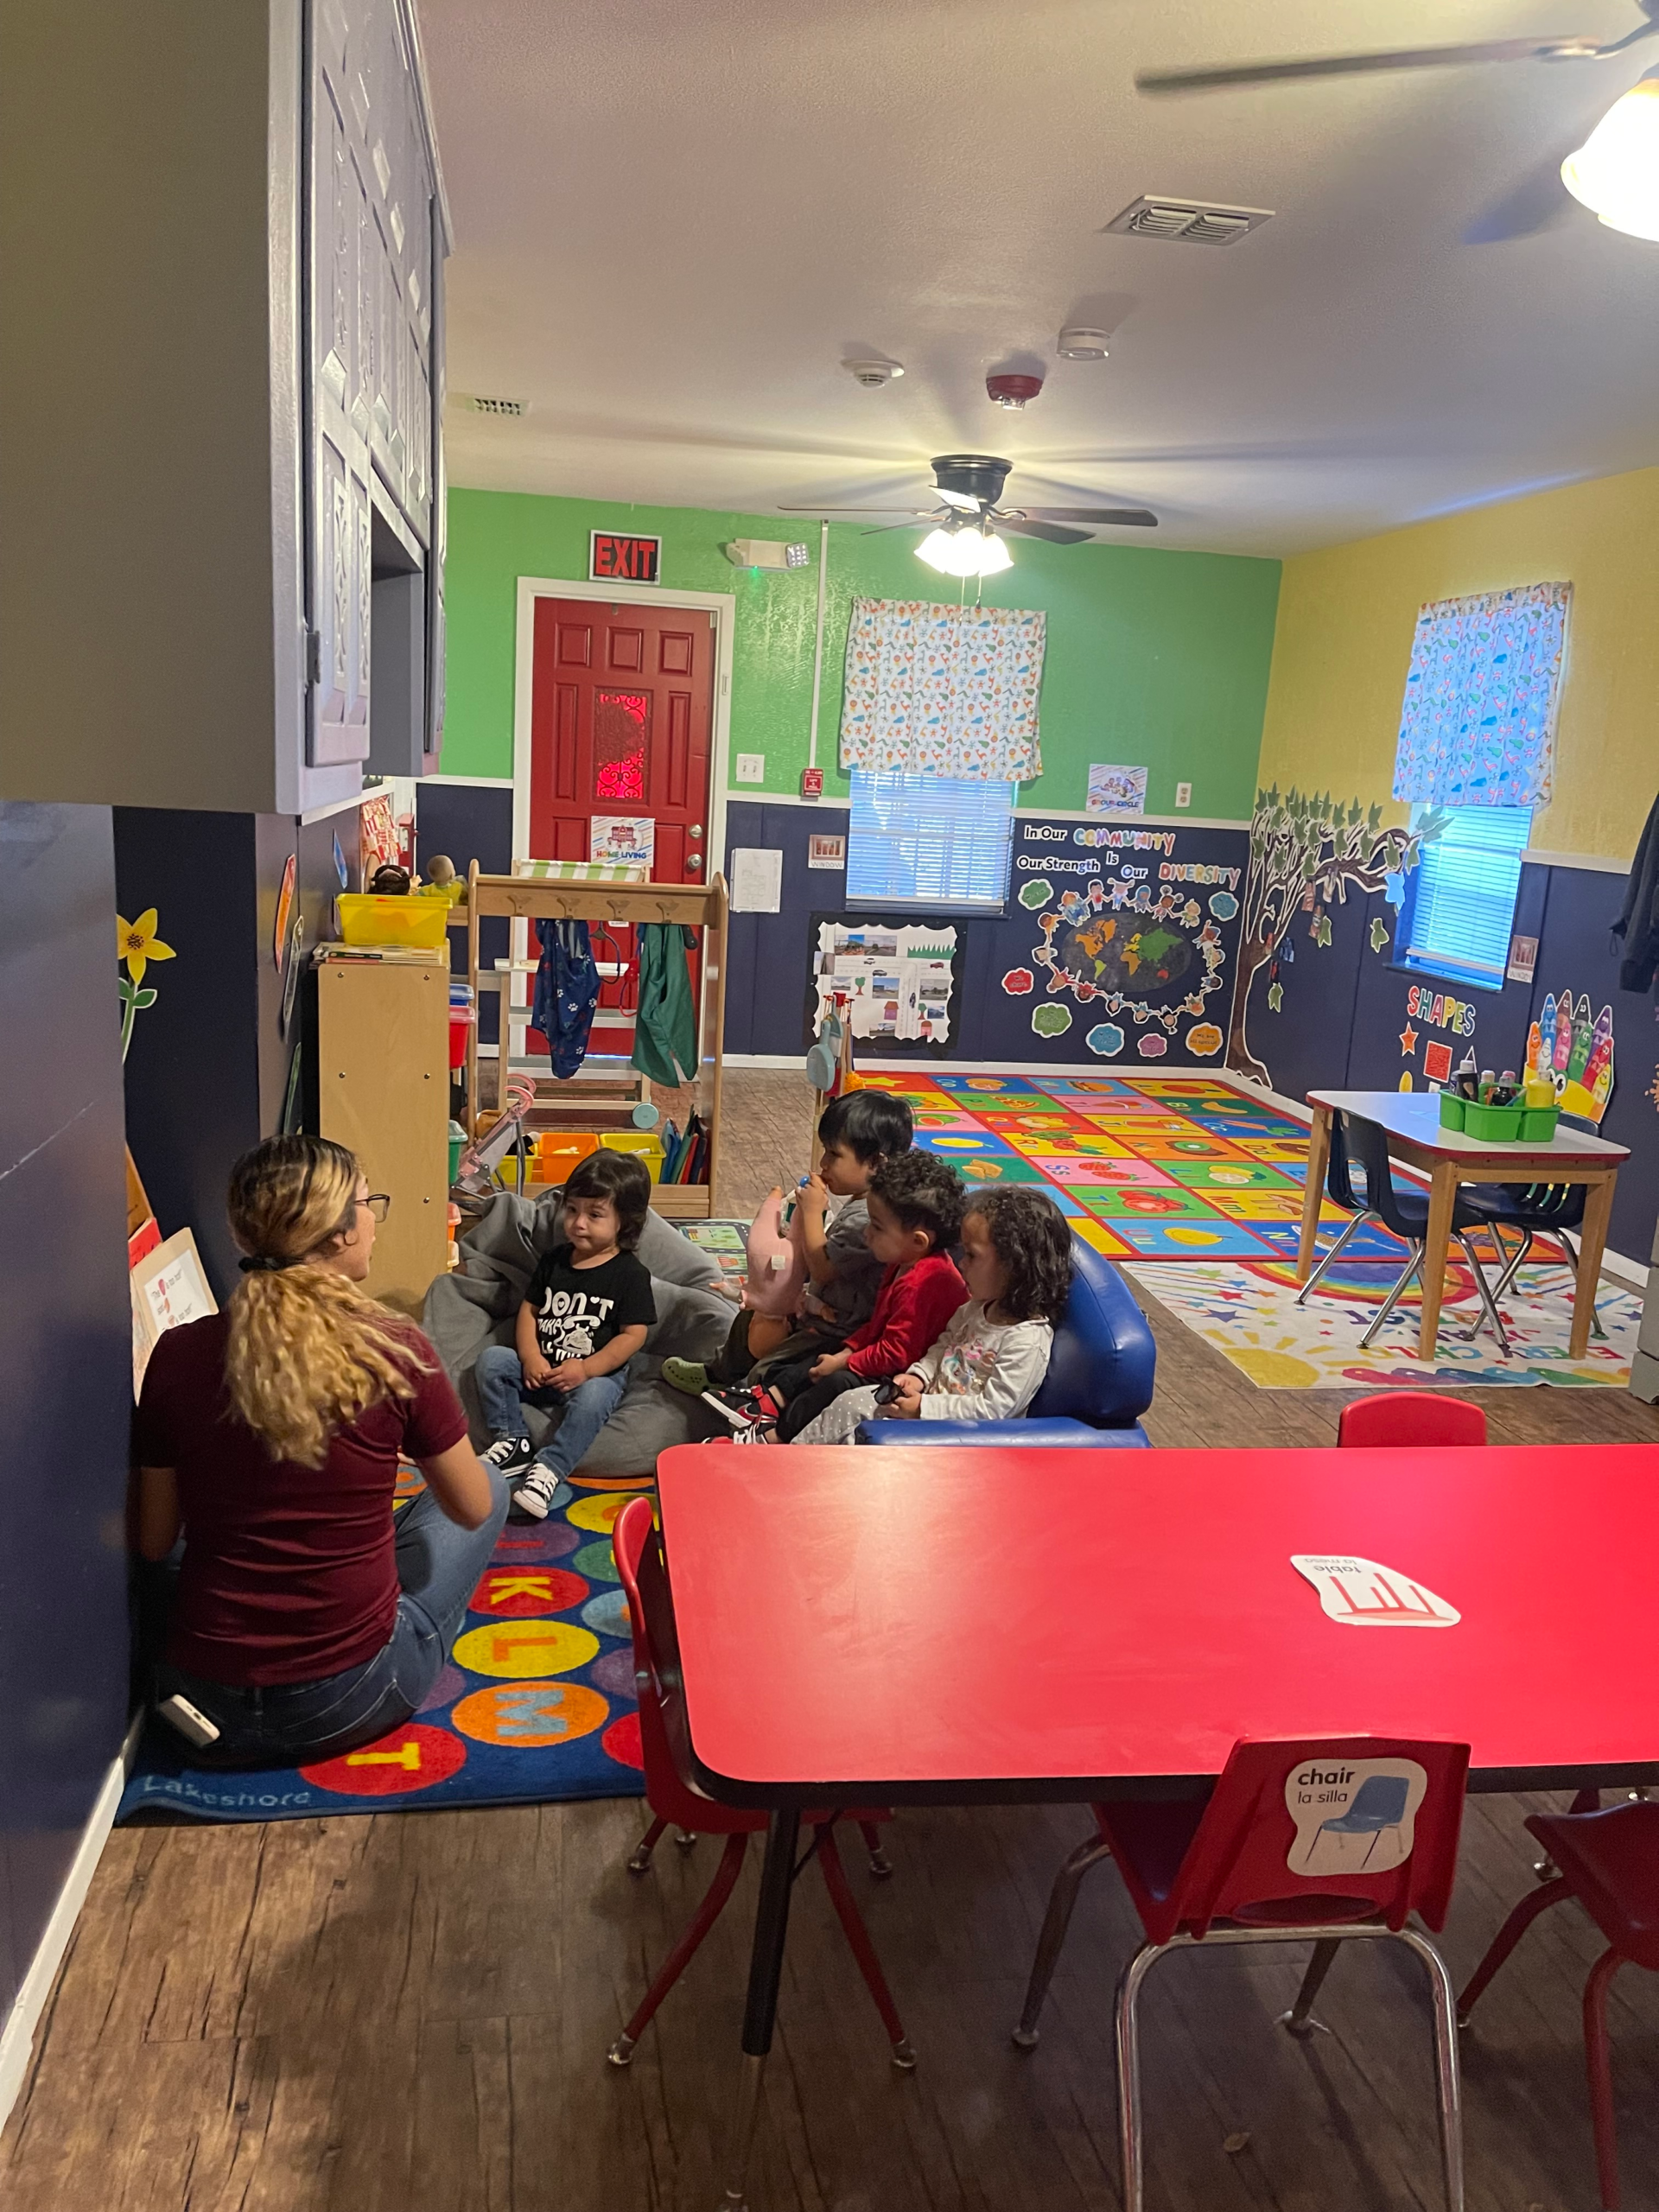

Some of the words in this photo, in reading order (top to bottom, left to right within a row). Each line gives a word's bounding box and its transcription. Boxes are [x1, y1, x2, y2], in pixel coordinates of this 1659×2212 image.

[595, 537, 656, 579] EXIT
[1025, 826, 1037, 838] In
[1041, 827, 1067, 839] Our
[1073, 828, 1175, 856] COMMUNITY
[1018, 856, 1043, 868] Our
[1046, 858, 1099, 873] Strength
[1107, 851, 1118, 864] Is
[1122, 865, 1147, 878] Our
[1159, 862, 1242, 891] DIVERSITY
[1407, 985, 1477, 1037] SHAPES
[1313, 1565, 1362, 1573] table
[488, 1576, 553, 1605] K
[493, 1636, 557, 1662] L
[494, 1689, 568, 1738] M
[346, 1741, 421, 1770] T
[1298, 1766, 1356, 1786] chair
[143, 1775, 312, 1807] Lakeshore
[1298, 1790, 1312, 1804] la
[1317, 1789, 1348, 1803] silla
